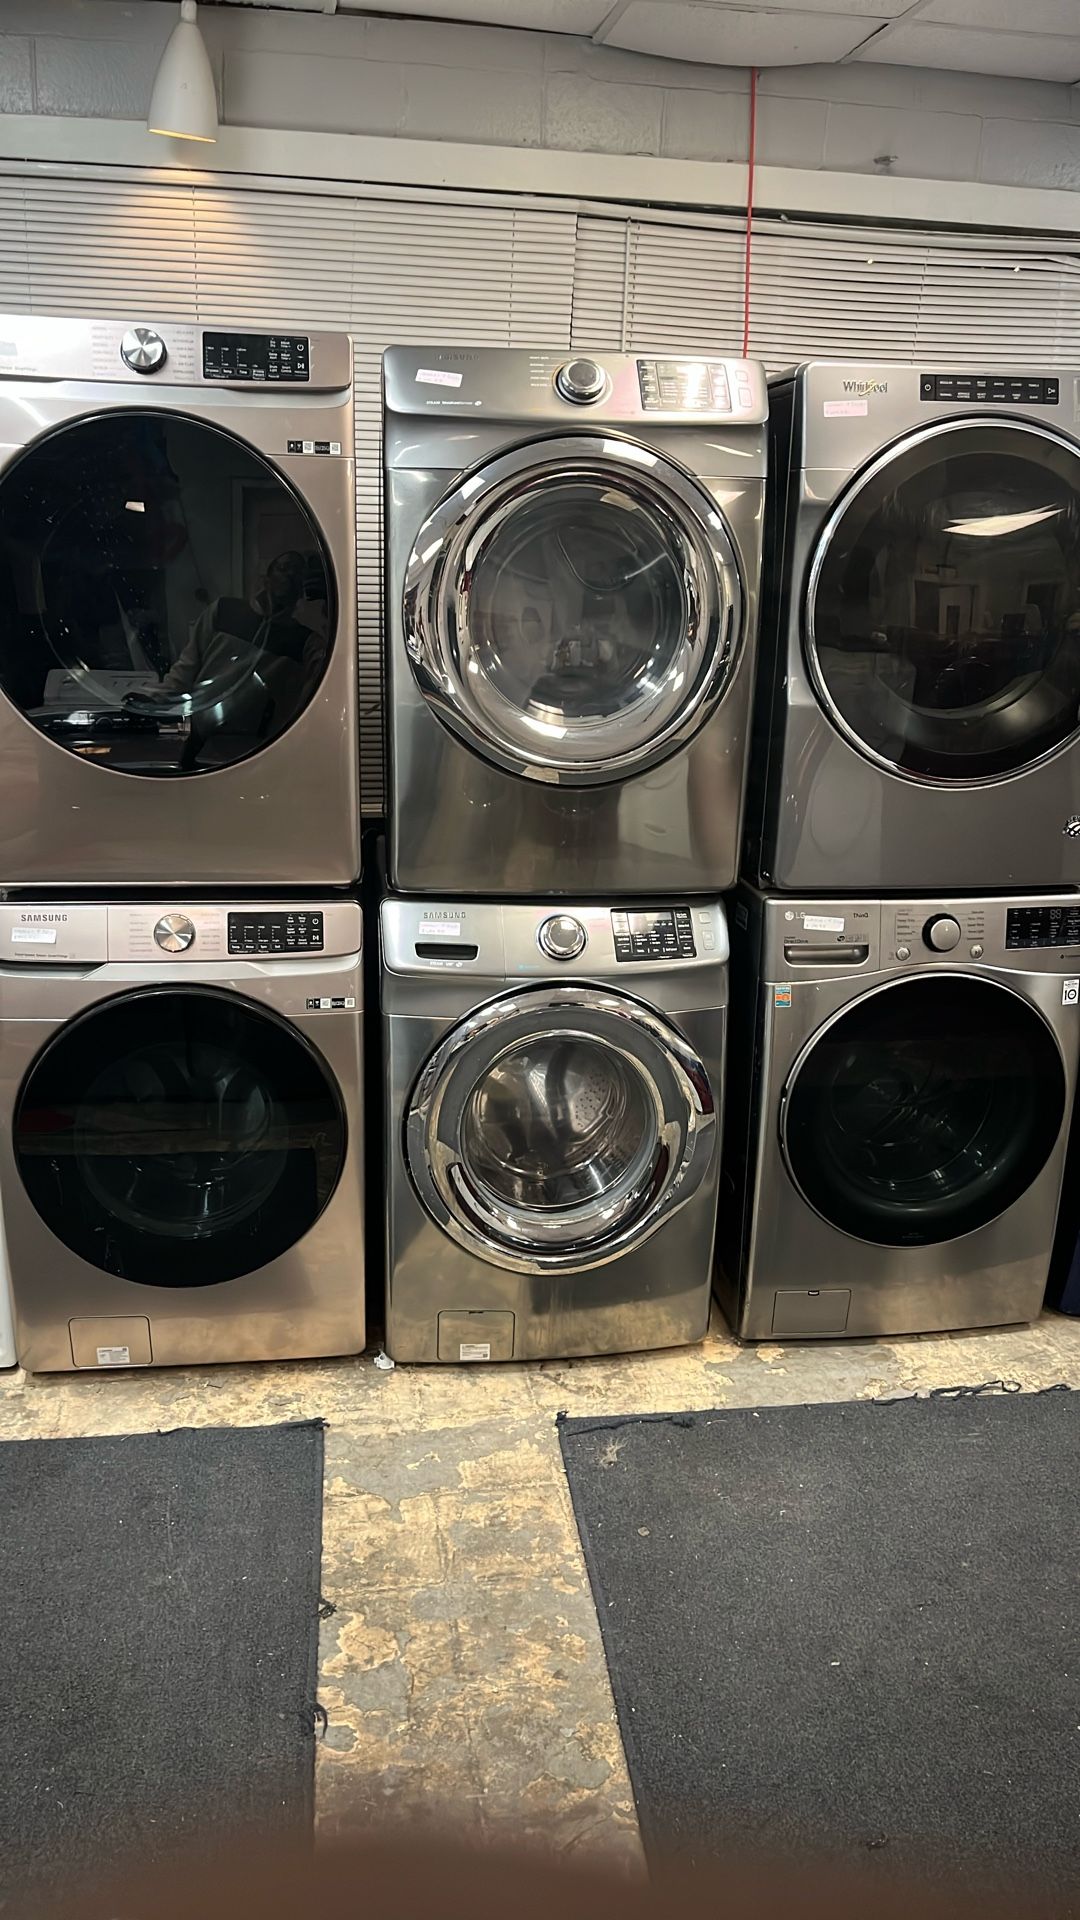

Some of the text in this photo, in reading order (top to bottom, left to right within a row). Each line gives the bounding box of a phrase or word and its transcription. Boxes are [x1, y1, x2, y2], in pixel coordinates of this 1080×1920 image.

[843, 380, 888, 396] Whirlpool
[21, 914, 68, 922] SAMSUNG
[423, 911, 466, 919] SAMSUNG
[795, 911, 806, 919] LG
[1064, 989, 1077, 1001] 10
